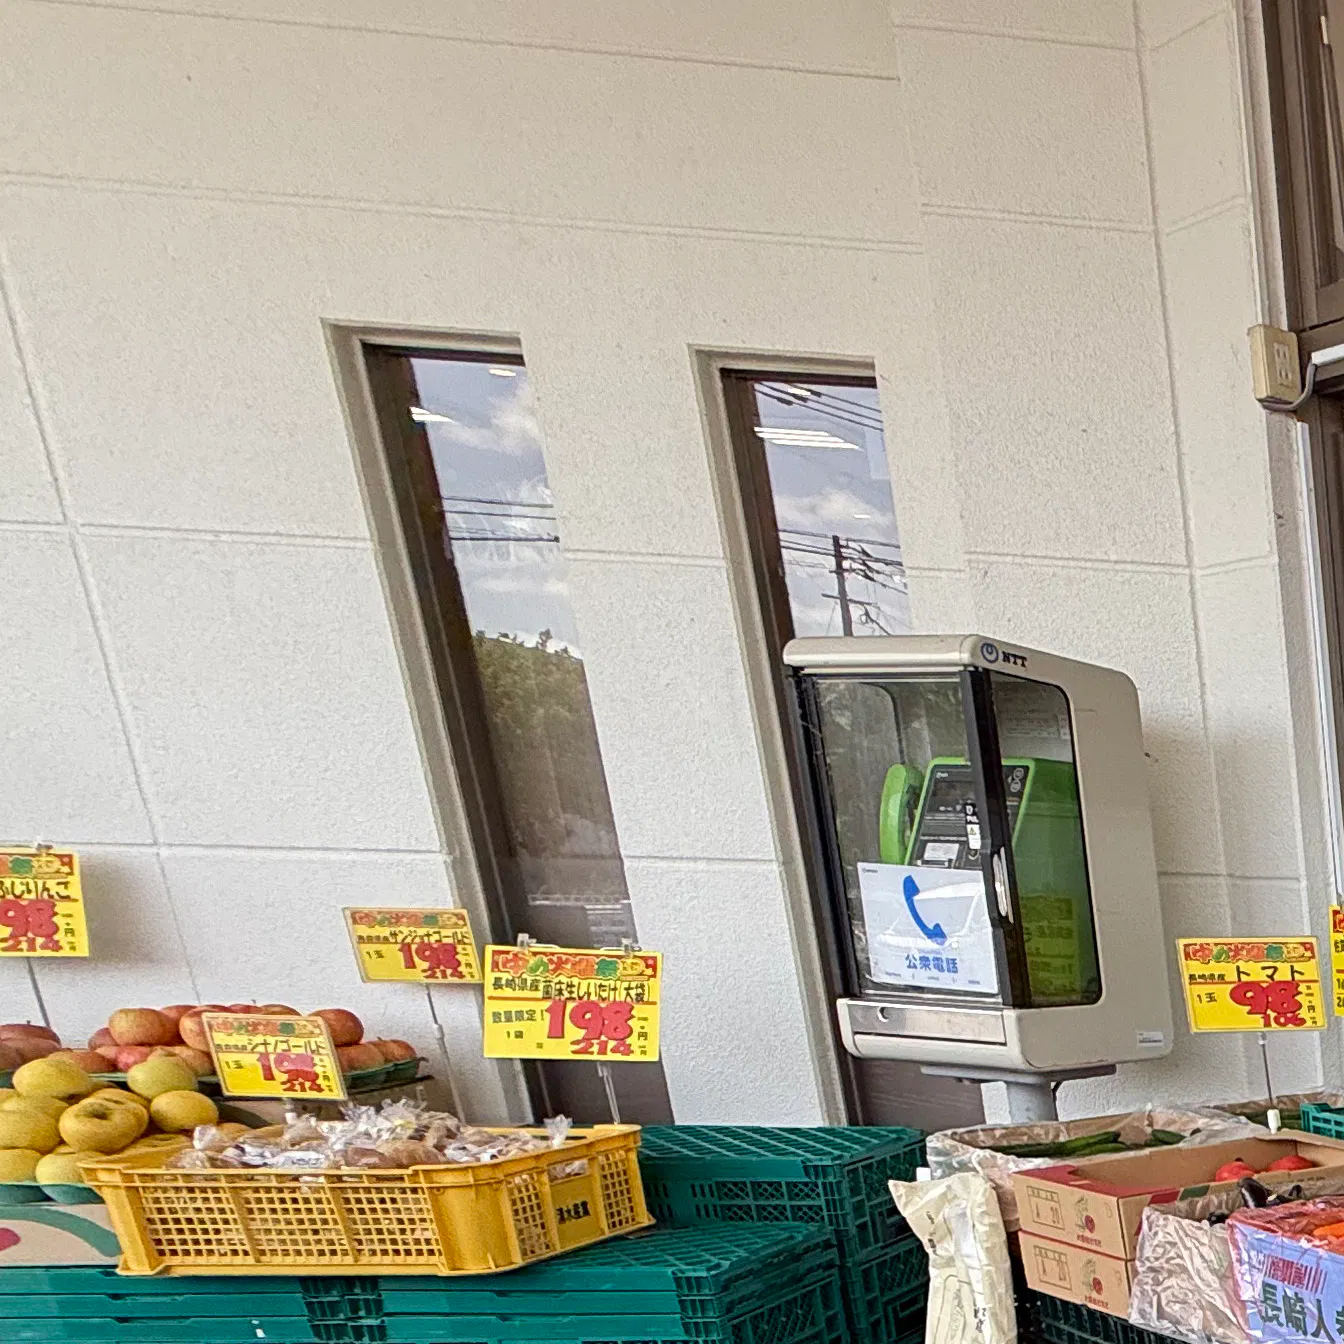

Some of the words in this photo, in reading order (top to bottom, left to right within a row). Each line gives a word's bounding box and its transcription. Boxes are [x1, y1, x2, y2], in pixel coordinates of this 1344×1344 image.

[1002, 651, 1028, 668] NTT
[905, 954, 958, 974] 公衆電話
[1235, 964, 1305, 983] トマト
[492, 976, 541, 992] 長崎県産
[1196, 991, 1218, 1004] 1玉
[1229, 981, 1304, 1015] 98
[545, 1000, 636, 1041] 198
[569, 1038, 634, 1056] 214
